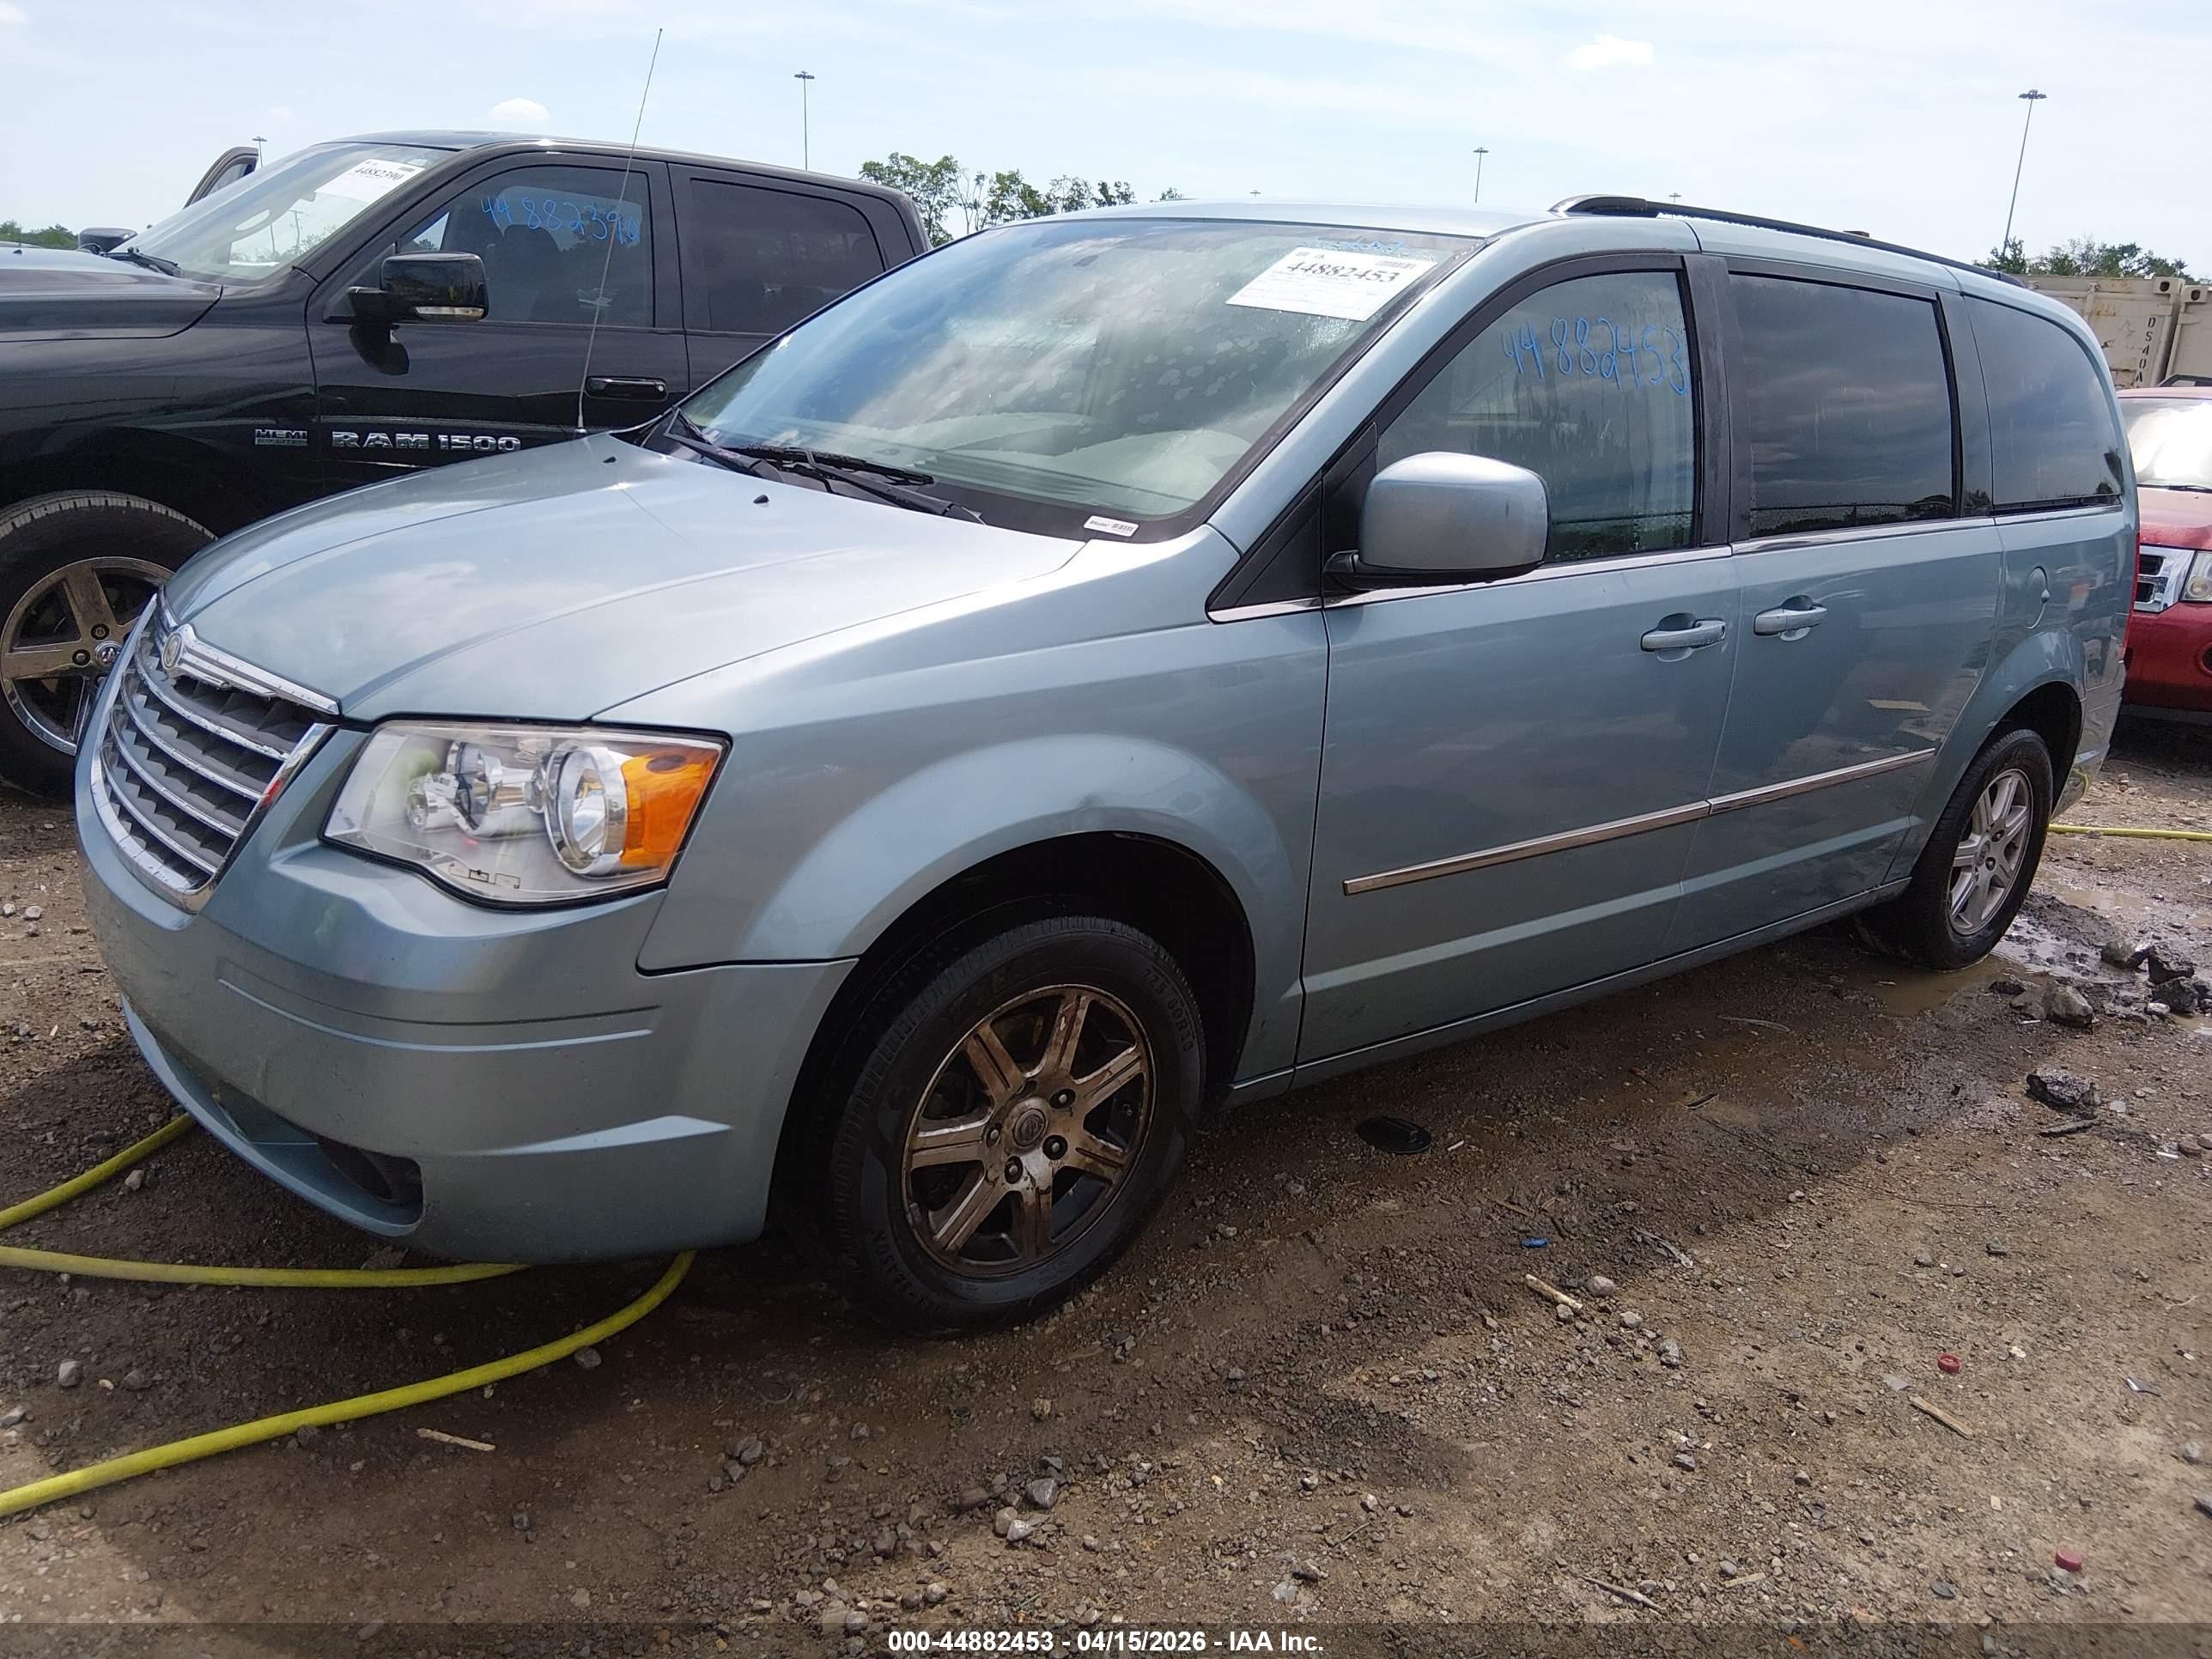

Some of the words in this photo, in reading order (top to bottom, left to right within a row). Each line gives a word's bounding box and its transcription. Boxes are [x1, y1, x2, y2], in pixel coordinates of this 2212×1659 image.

[481, 197, 641, 245] 44882390
[1286, 260, 1401, 283] 44882453
[1503, 315, 1689, 396] 44882453
[332, 430, 429, 450] RAM
[437, 434, 521, 452] 1500
